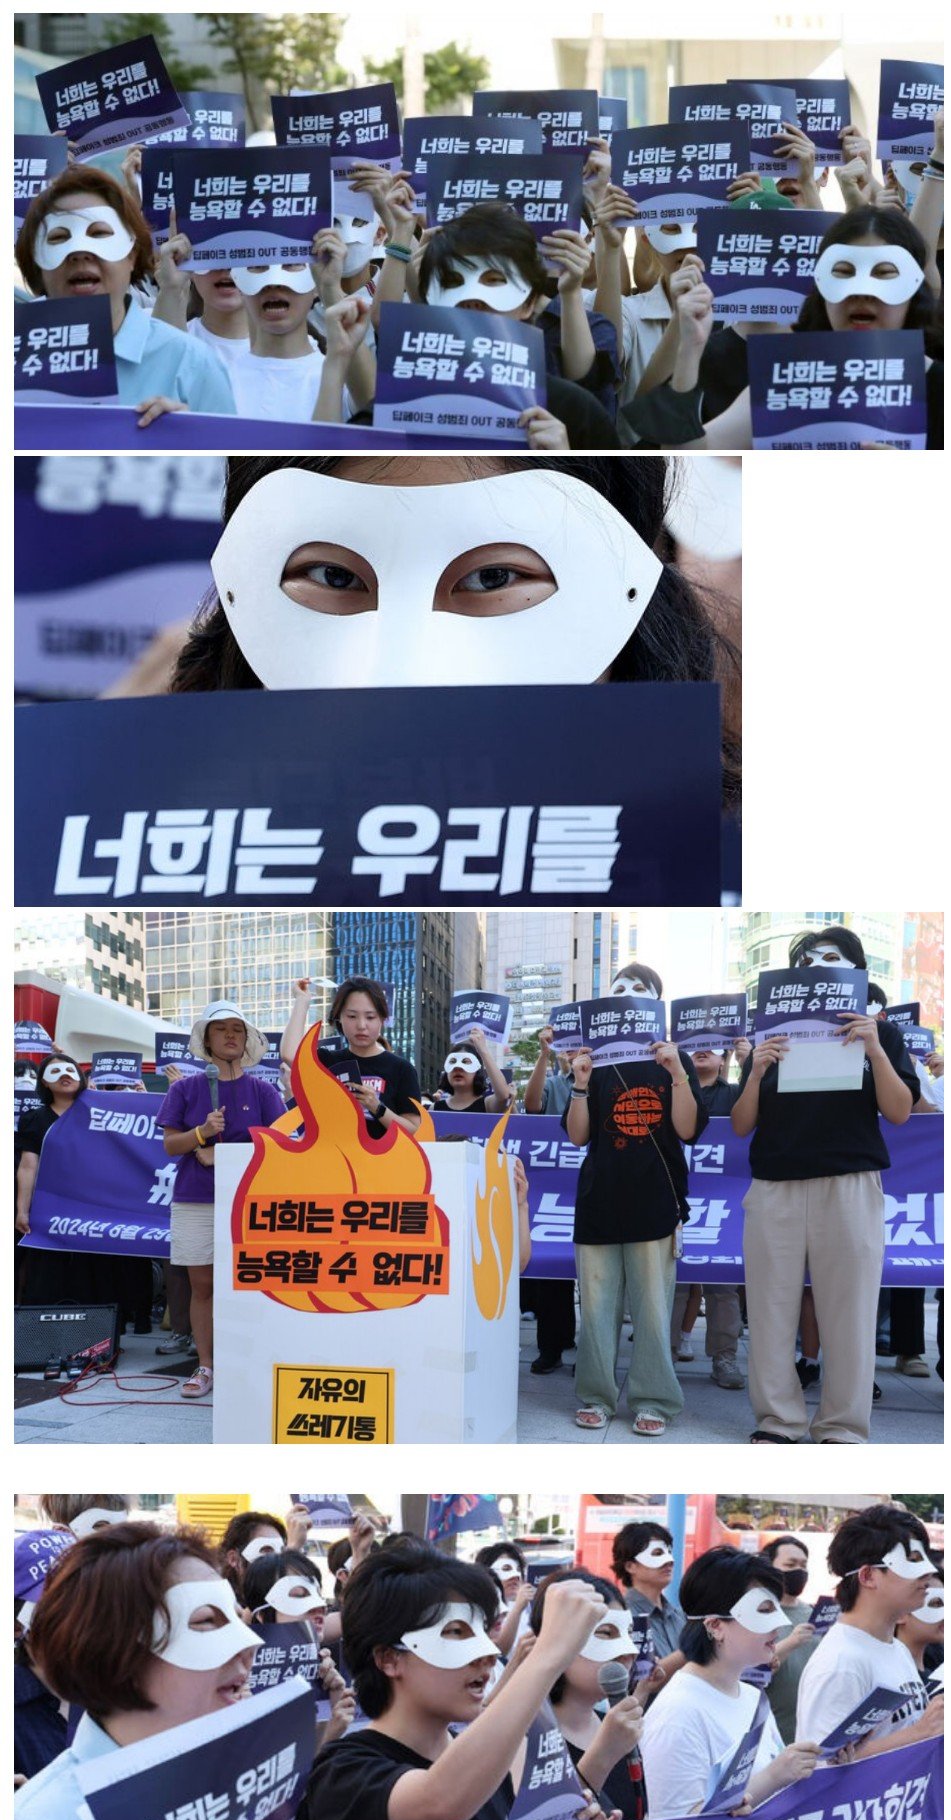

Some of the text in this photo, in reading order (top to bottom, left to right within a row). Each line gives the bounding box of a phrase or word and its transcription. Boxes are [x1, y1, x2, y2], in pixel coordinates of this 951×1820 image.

[194, 173, 310, 197] 너희는 우리를
[443, 179, 562, 199] 너희는 우리를
[190, 198, 317, 221] 능욕할 수 없다!
[524, 203, 568, 222] 없다!
[258, 247, 276, 257] OUT
[710, 258, 790, 276] 능욕할 수
[750, 303, 778, 314] 성범죄
[780, 305, 798, 314] OUT
[28, 324, 89, 350] 우리를
[402, 331, 528, 366] 너희는 우리를
[22, 349, 98, 376] 수 없다!
[393, 357, 535, 389] 능욕할 수 없다!
[773, 359, 904, 384] 너희는 우리를
[767, 385, 911, 410] 능욕할 수 없다!
[393, 411, 492, 425] 딥페이크 성범죄 OUT
[53, 804, 623, 897] 너희는 우리를
[770, 983, 854, 999] 너희는 우리를
[591, 1010, 655, 1025] 너희는 우리를
[765, 999, 821, 1014] 능욕할 수
[589, 1025, 617, 1039] 능욕할
[49, 1216, 141, 1240] 2024년 8월
[249, 1200, 429, 1234] 너희는 우리를
[237, 1251, 444, 1285] 능욕할 수 없다!
[39, 1313, 86, 1322] CUBE
[298, 1378, 366, 1403] 자유의
[287, 1414, 376, 1441] 쓰레기통
[236, 1742, 298, 1805] 우리를
